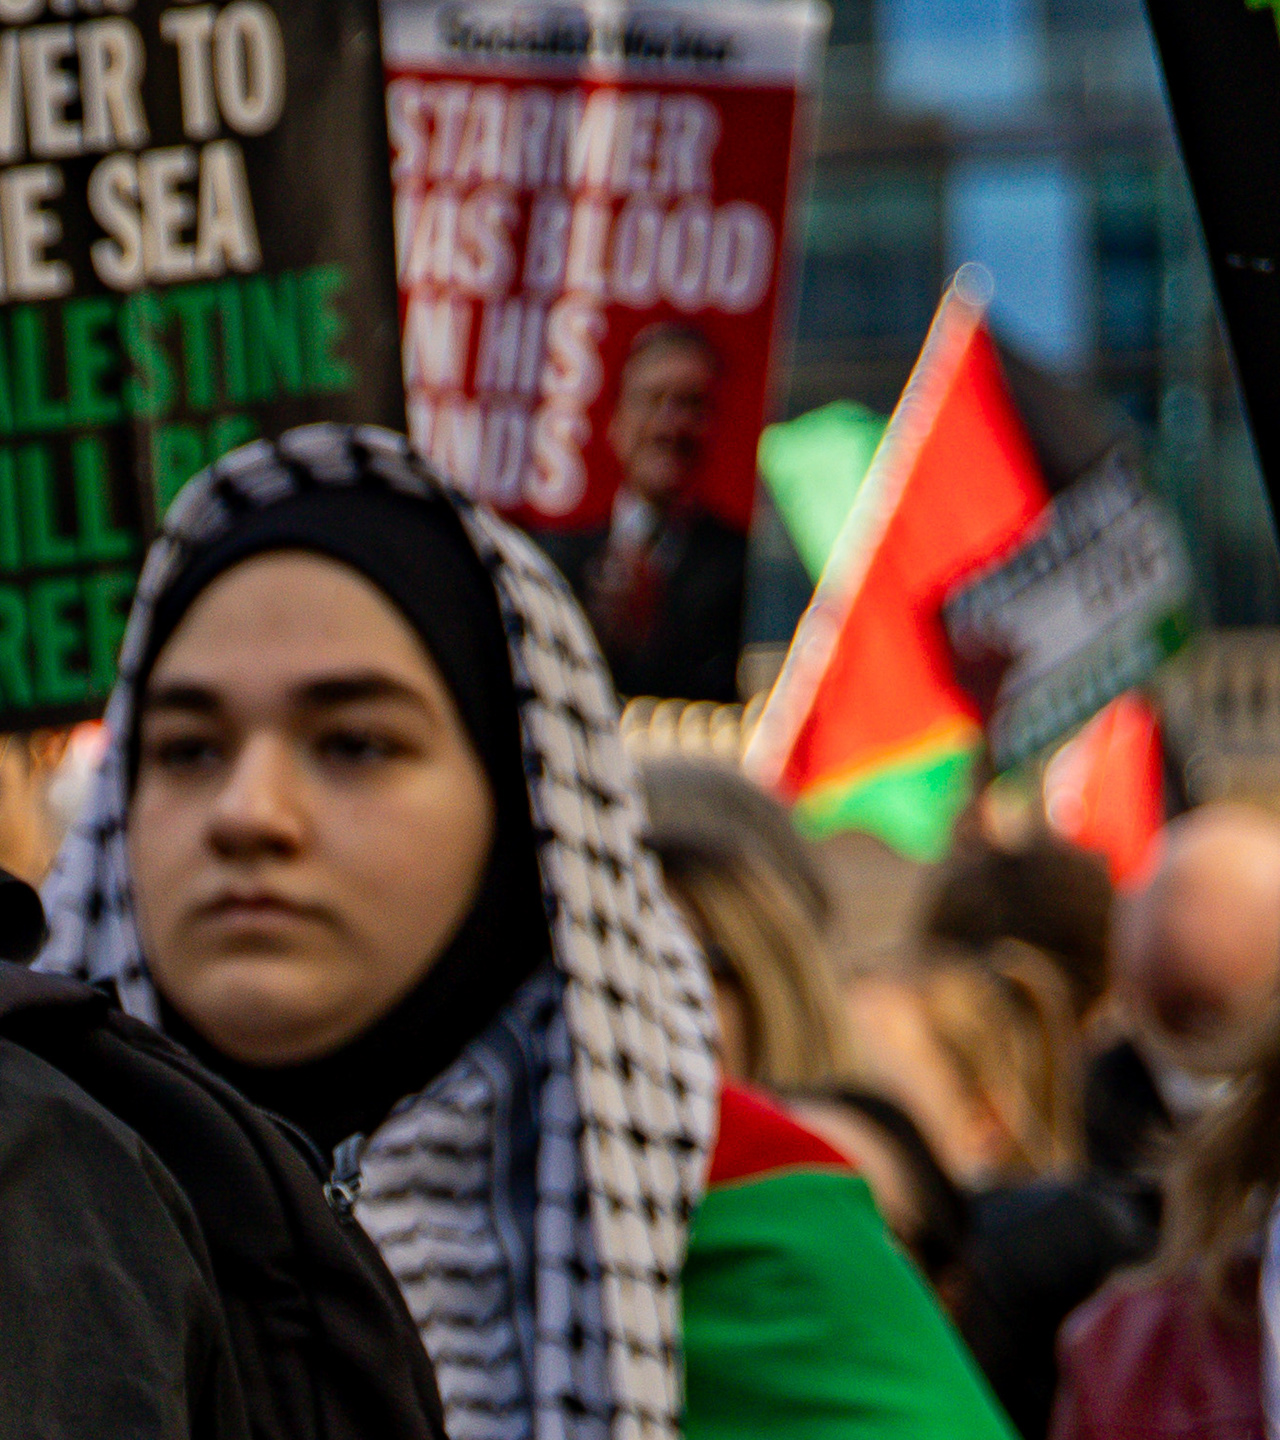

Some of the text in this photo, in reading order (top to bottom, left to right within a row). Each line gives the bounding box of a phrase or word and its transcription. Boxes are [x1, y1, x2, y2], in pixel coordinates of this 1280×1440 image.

[161, 0, 288, 139] TO
[386, 77, 723, 197] STARMER
[88, 141, 262, 292] SEA
[523, 189, 777, 314] BLOOD
[153, 414, 258, 527] B
